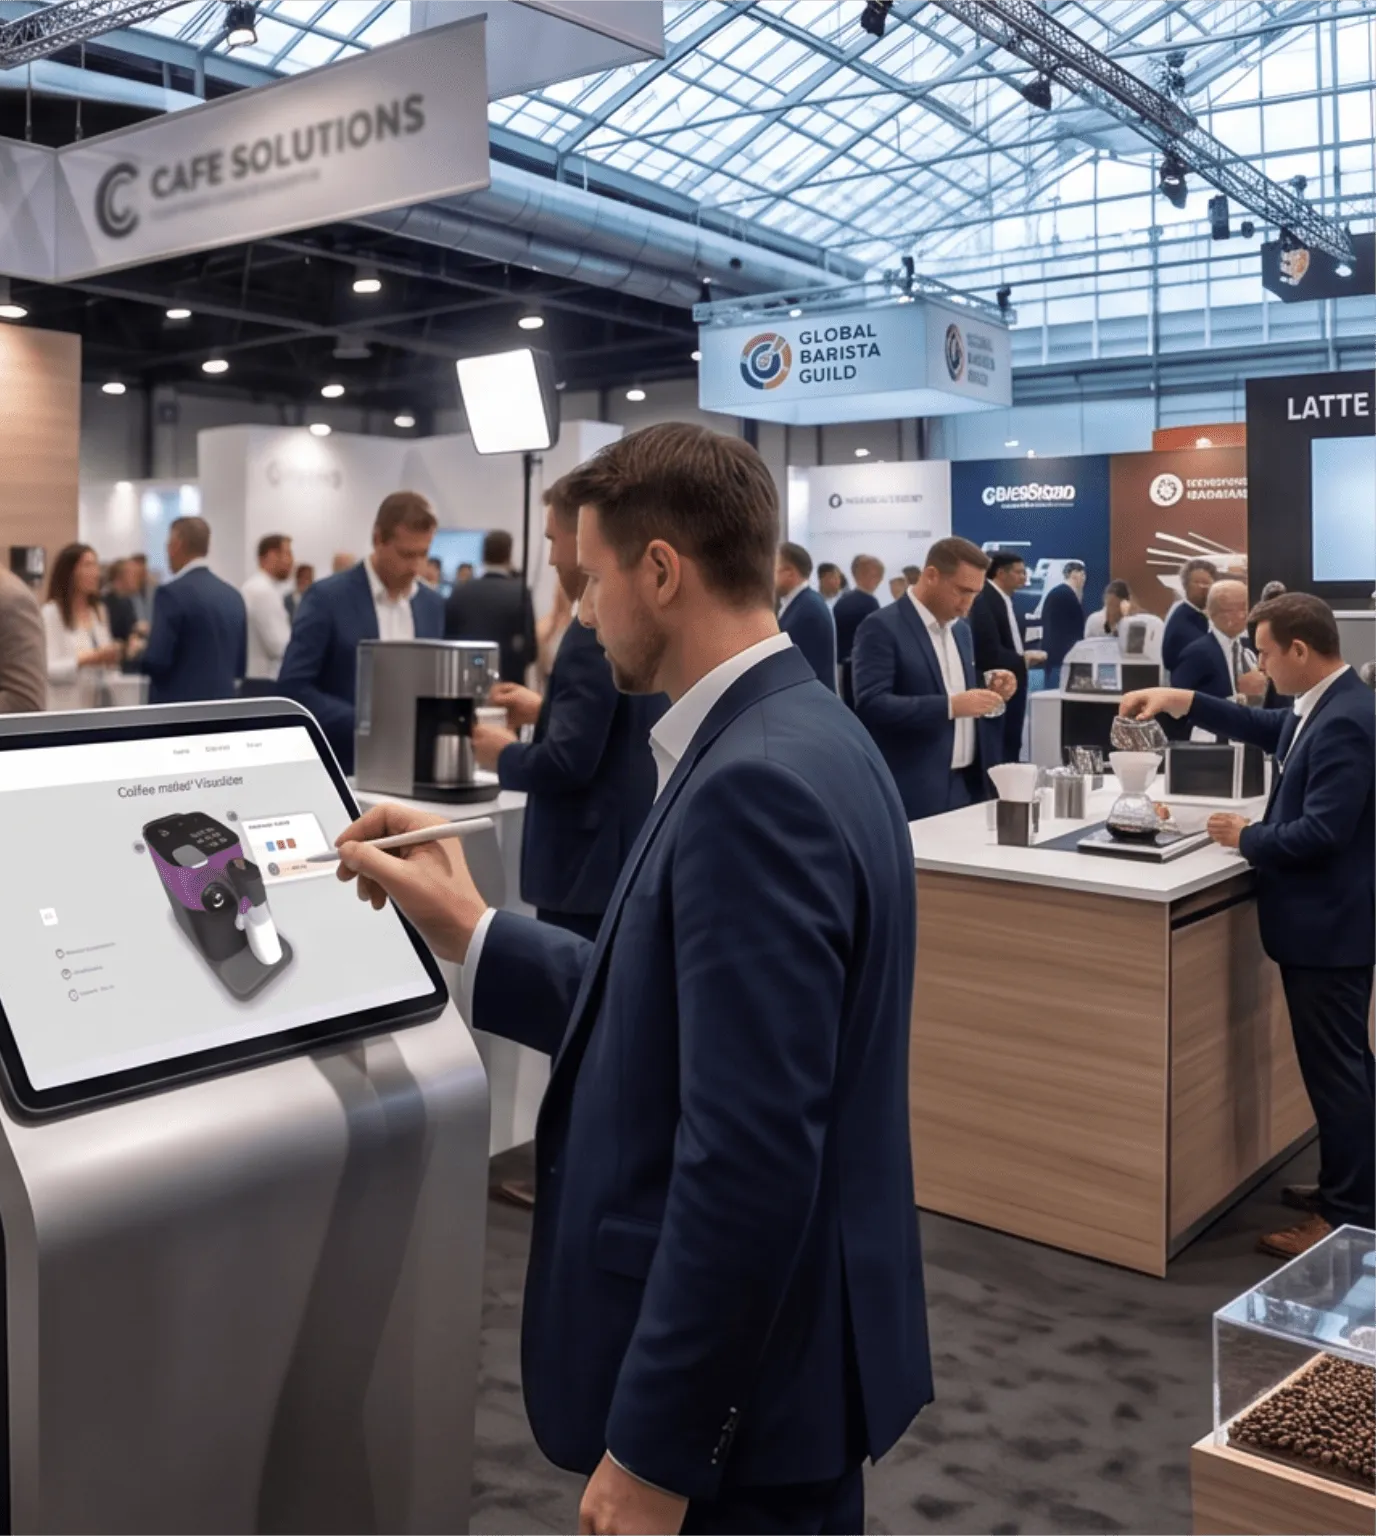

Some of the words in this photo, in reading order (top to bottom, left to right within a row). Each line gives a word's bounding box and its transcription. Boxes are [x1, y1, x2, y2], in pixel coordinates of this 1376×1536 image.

[150, 150, 223, 198] CAFE
[231, 94, 425, 179] SOLUTIONS
[799, 324, 876, 345] GLOBAL
[800, 343, 881, 364] BARISTA
[799, 365, 857, 383] GUILD
[1288, 392, 1369, 421] LATTE
